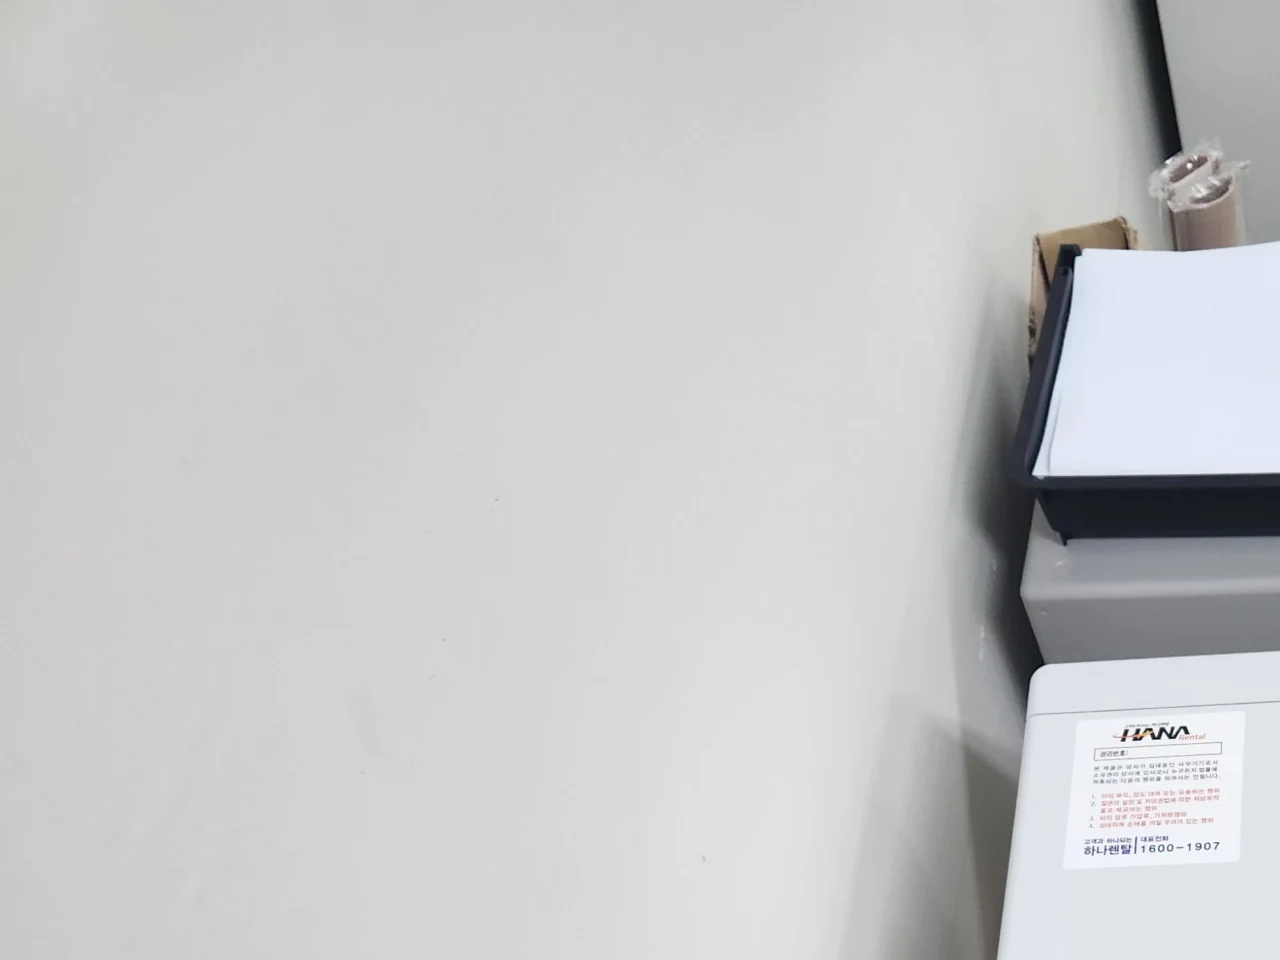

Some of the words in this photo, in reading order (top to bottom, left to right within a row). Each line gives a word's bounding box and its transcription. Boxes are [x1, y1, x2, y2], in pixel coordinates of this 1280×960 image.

[1120, 726, 1190, 742] HANA
[1179, 733, 1205, 741] Rental
[1084, 844, 1132, 856] 하나렌탈
[1141, 842, 1220, 853] 1600-1907
